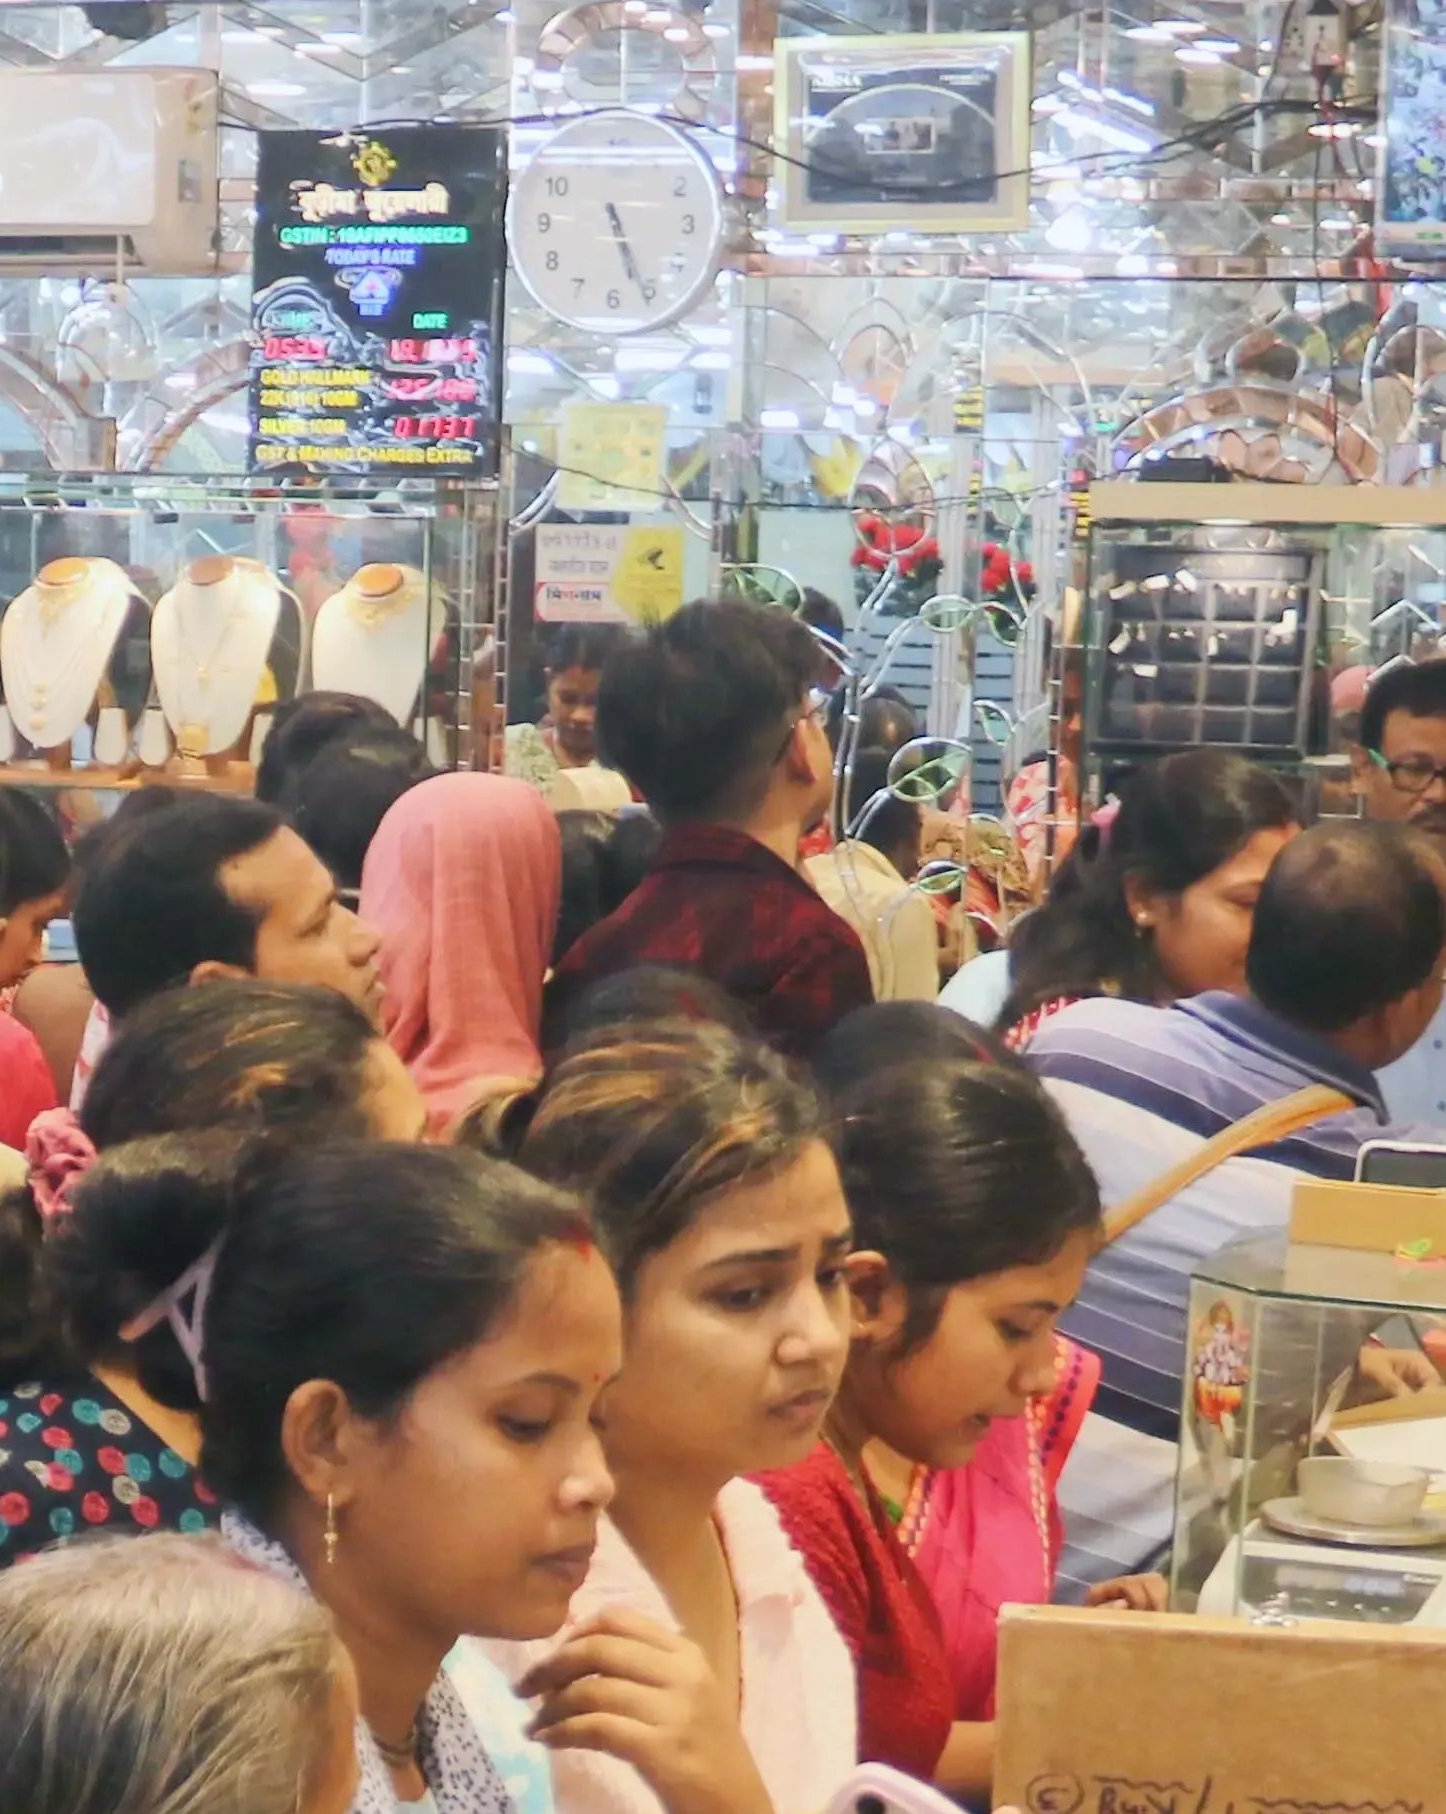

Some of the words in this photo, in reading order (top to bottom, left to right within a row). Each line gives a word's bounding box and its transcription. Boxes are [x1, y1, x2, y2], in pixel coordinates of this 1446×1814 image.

[545, 177, 568, 197] 10
[674, 177, 687, 197] 2
[538, 213, 551, 233] 9
[682, 214, 695, 234] 3
[382, 248, 417, 265] RATE
[546, 251, 559, 271] 8
[571, 278, 586, 298] 7
[606, 289, 620, 309] 6
[413, 313, 448, 329] DATE
[260, 369, 299, 386] GOLD
[299, 444, 357, 462] MAKING
[358, 445, 425, 463] CHARGES
[426, 446, 474, 464] EXTRA
